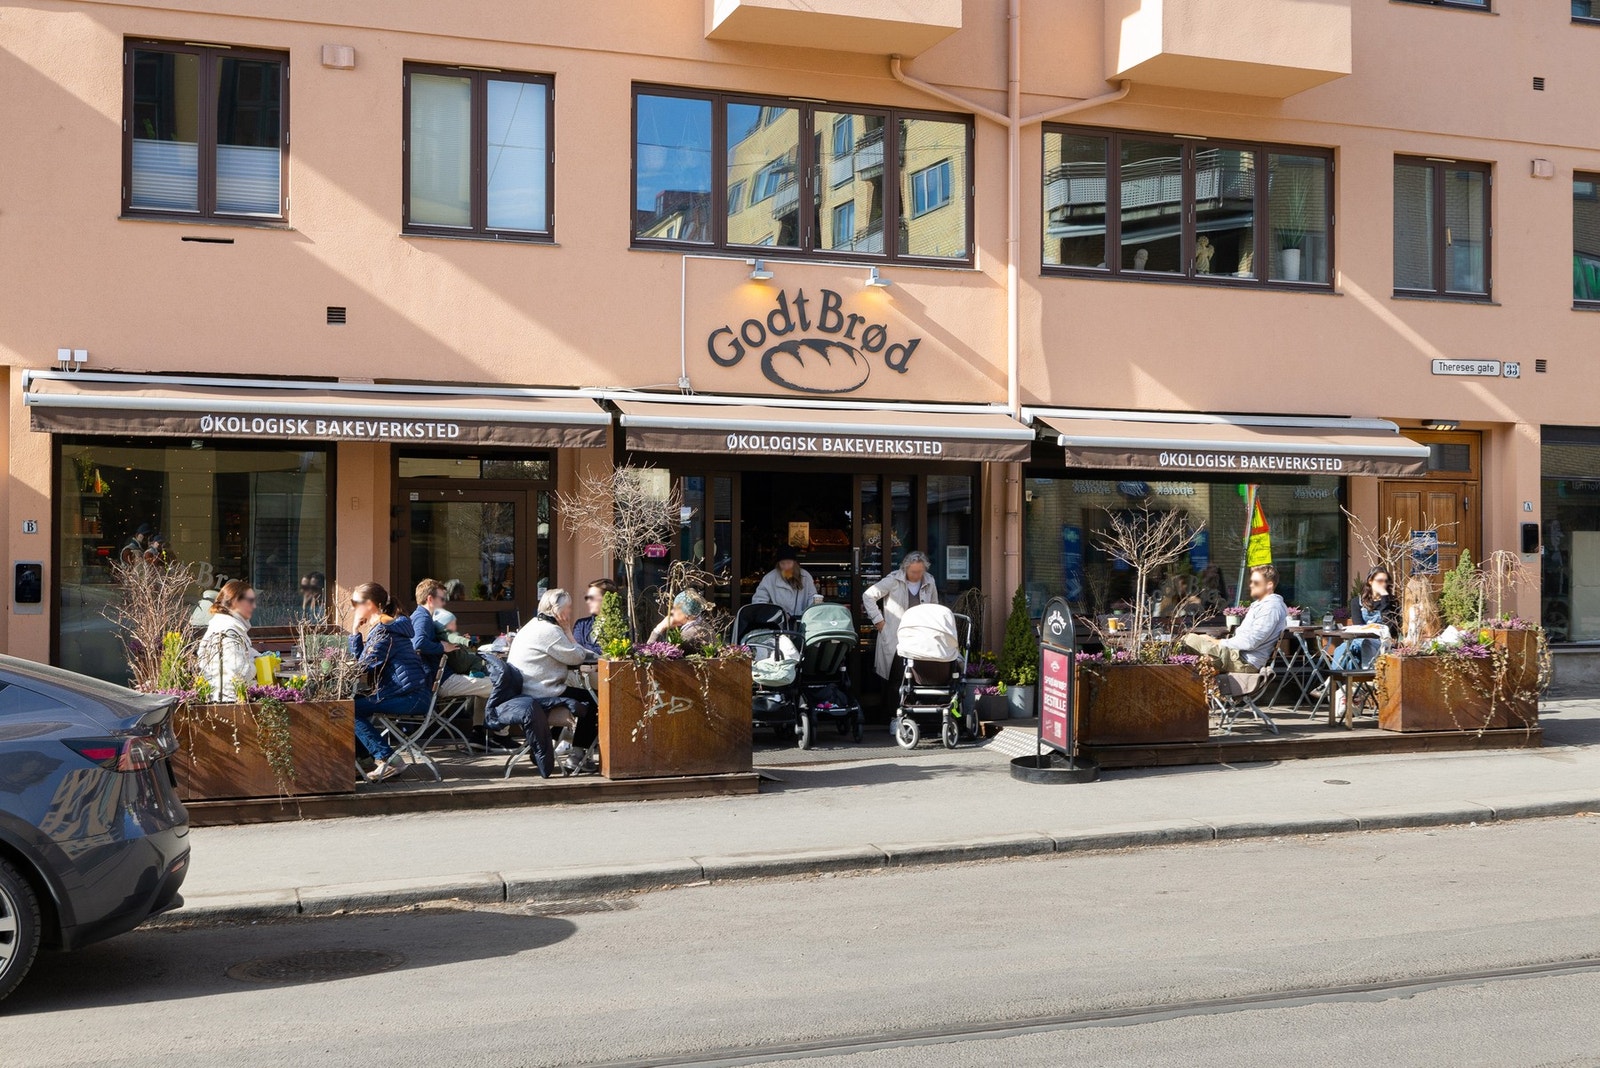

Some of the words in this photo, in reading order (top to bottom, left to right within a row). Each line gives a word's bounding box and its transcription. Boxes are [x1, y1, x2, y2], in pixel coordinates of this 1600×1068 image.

[707, 287, 811, 368] Godt
[816, 288, 922, 374] Brød
[1439, 362, 1475, 372] Thereses
[1477, 364, 1495, 374] gate
[1506, 364, 1518, 376] 33
[200, 414, 309, 435] ØKOLOGISK
[316, 420, 459, 438] BAKEVERKSTED
[726, 433, 818, 451] ØKOLOGISK
[822, 438, 942, 455] BAKEVERKSTED
[1159, 451, 1236, 467] ØKOLOGISK
[1240, 455, 1342, 471] BAKEVERKSTED
[27, 522, 34, 532] B
